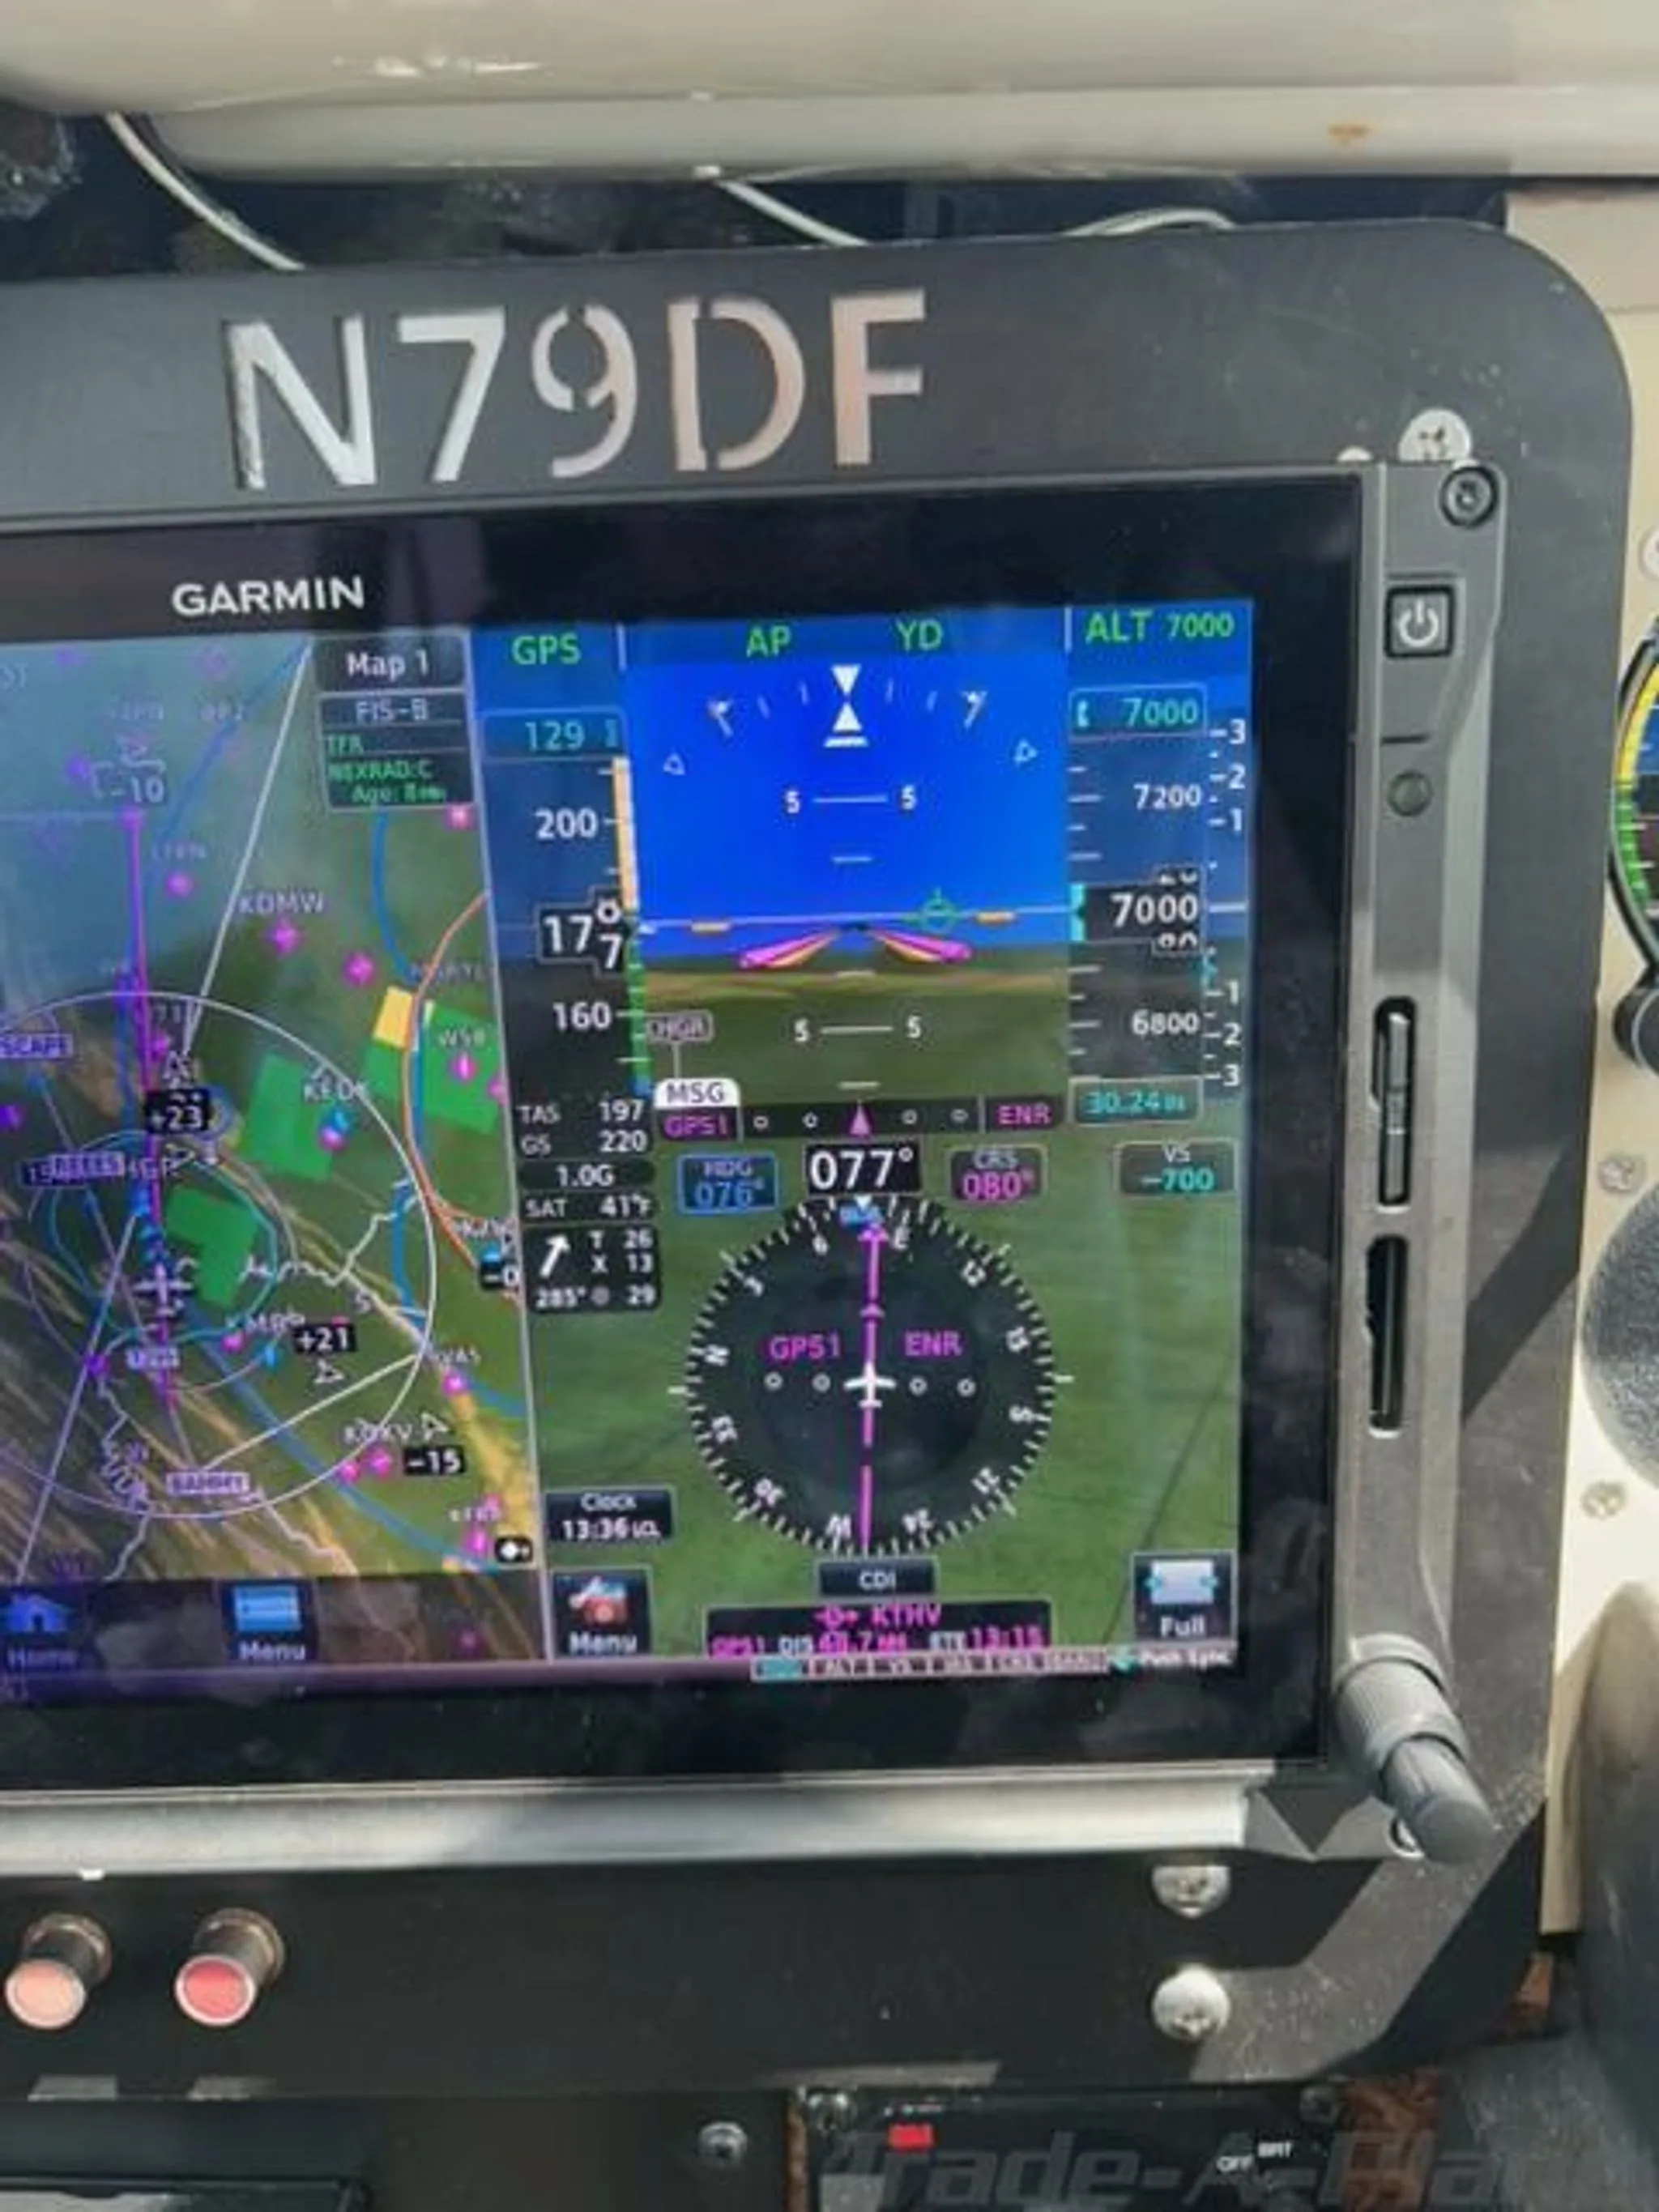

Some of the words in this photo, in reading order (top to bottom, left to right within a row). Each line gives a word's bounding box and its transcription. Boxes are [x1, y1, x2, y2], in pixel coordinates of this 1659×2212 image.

[224, 288, 926, 489] N79DF
[171, 574, 365, 618] GARMIN
[897, 619, 943, 650] YD
[1084, 611, 1154, 643] ALT
[1167, 612, 1235, 638] 7000
[511, 633, 582, 666] GPS
[745, 625, 792, 658] AP
[347, 650, 407, 680] Map
[416, 650, 430, 674] 1
[1123, 697, 1199, 727] 7000
[525, 720, 586, 752] 129
[1229, 719, 1247, 745] 3
[1229, 764, 1246, 791] 2
[783, 790, 802, 816] 5
[900, 784, 918, 811] 5
[1134, 783, 1203, 811] 7200
[534, 808, 599, 841] 200
[1230, 809, 1243, 833] 1
[1111, 893, 1199, 928] 7000
[1226, 981, 1239, 1004] 1
[552, 1002, 612, 1032] 160
[794, 1018, 811, 1043] 5
[906, 1016, 922, 1040] 5
[1131, 1009, 1200, 1036] 6800
[1223, 1022, 1242, 1047] 2
[1223, 1063, 1241, 1088] 3
[666, 1082, 726, 1105] MSG
[517, 1105, 561, 1125] TAS
[599, 1100, 645, 1123] 197
[996, 1102, 1051, 1125] ENR
[520, 1136, 552, 1157] GS
[599, 1130, 647, 1154] 220
[1162, 1144, 1191, 1163] VS
[556, 1163, 616, 1188] 1.0G
[810, 1145, 914, 1191] 077°
[525, 1199, 568, 1219] SAT
[591, 1255, 608, 1273] X
[768, 1332, 840, 1361] GPS1
[904, 1330, 963, 1358] ENR
[859, 1571, 897, 1591] CDI
[1160, 1616, 1206, 1639] Full
[239, 1641, 306, 1664] Menu
